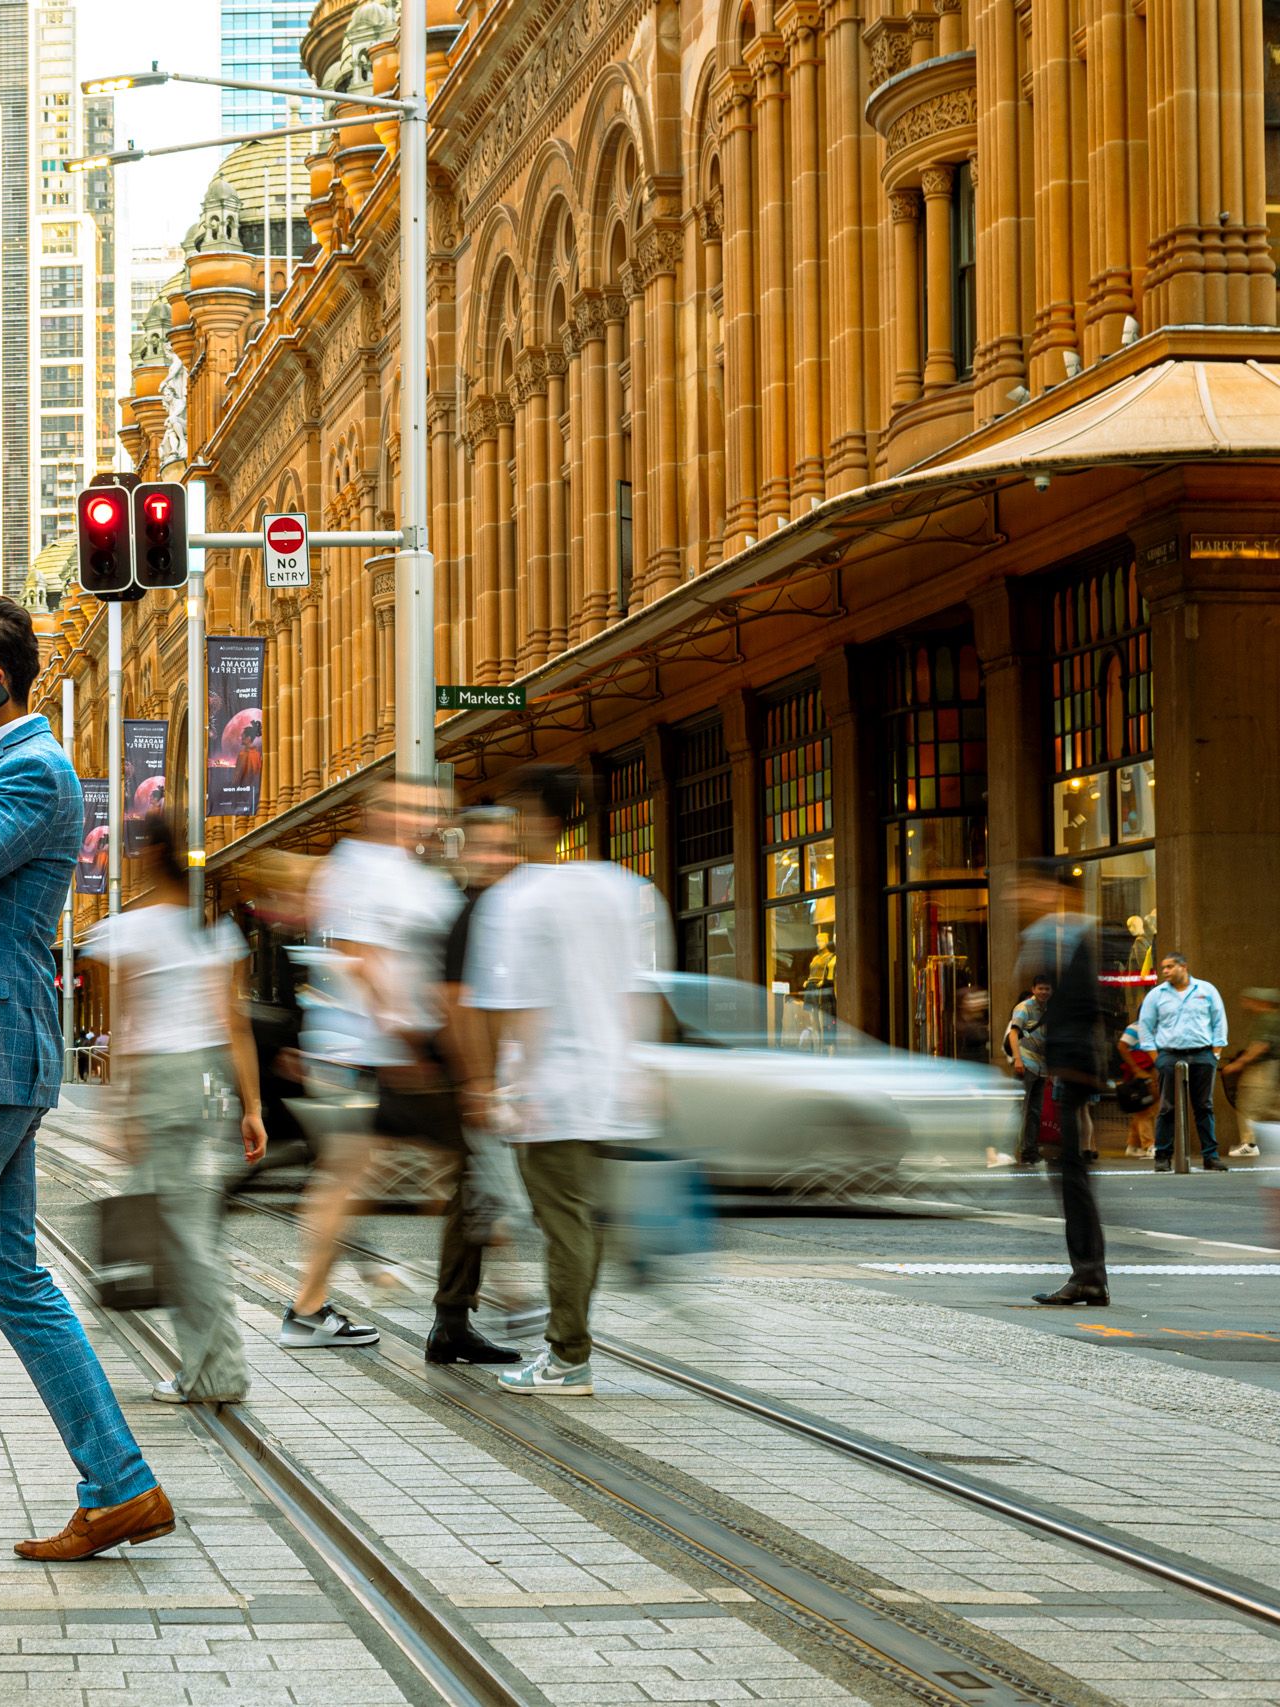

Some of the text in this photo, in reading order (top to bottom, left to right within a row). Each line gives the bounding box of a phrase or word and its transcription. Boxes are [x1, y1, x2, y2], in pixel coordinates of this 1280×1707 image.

[151, 502, 167, 519] T
[1194, 540, 1269, 552] MARKET ST
[277, 558, 297, 569] NO
[270, 572, 305, 581] ENTRY
[459, 691, 521, 705] Market St
